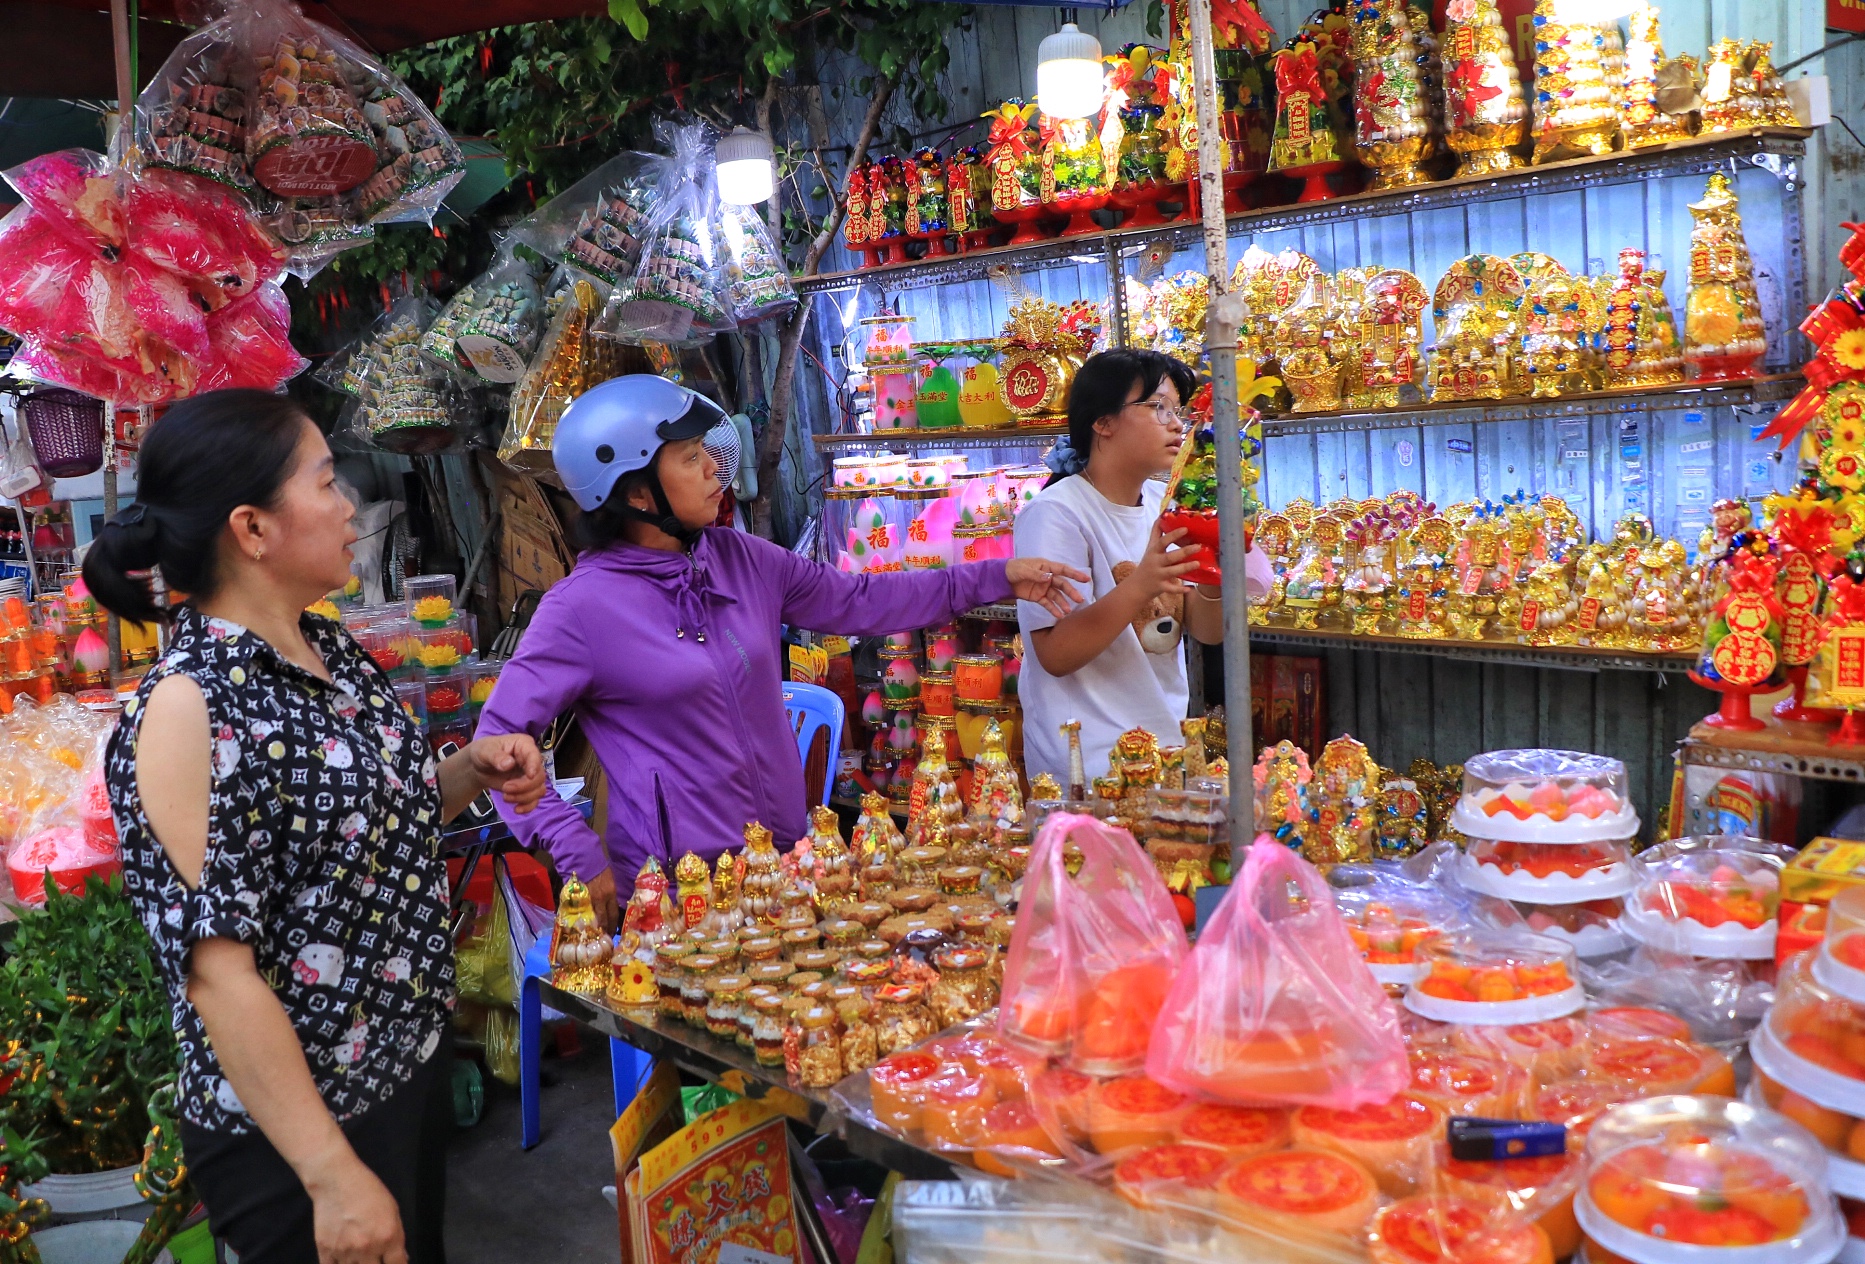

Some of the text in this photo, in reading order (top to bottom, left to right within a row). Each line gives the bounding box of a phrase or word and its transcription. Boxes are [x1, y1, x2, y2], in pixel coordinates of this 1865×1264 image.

[875, 329, 888, 342] 福
[920, 364, 933, 378] 福
[964, 366, 977, 380] 福
[854, 472, 865, 484] 福
[907, 519, 928, 542] 福
[866, 526, 890, 550] 福
